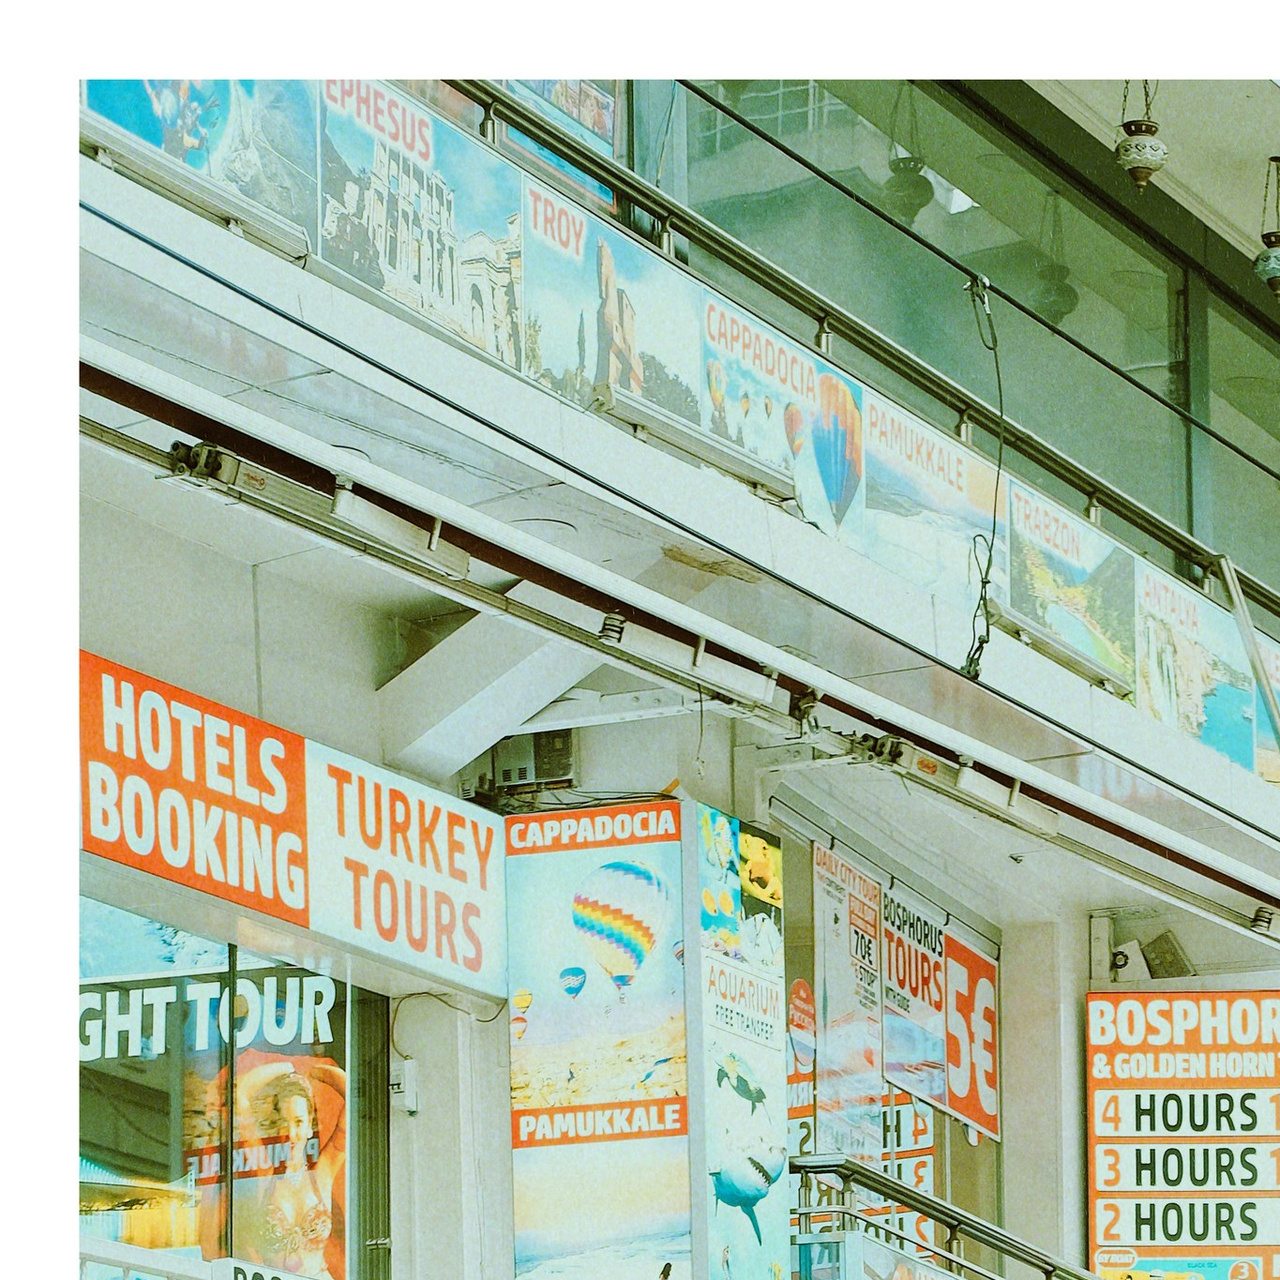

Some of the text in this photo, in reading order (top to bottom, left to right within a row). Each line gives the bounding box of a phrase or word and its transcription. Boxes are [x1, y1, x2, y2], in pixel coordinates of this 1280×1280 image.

[325, 79, 430, 161] EPHESUS
[528, 189, 584, 256] TROY
[706, 303, 816, 404] CAPPADOCIA
[869, 403, 964, 493] PAMUKKALE
[1013, 493, 1080, 559] TRABZON
[101, 673, 288, 815] HOTELS
[87, 761, 306, 910] BOOKING
[327, 763, 494, 891] TURKEY
[509, 809, 676, 849] CAPPADOCIA
[344, 857, 482, 974] TOURS
[882, 890, 945, 958] BOSPHORUS
[707, 965, 780, 1020] AQUARIUM
[884, 927, 944, 1014] TOURS
[187, 975, 337, 1052] TOUR
[714, 1003, 734, 1028] FREE
[735, 1008, 775, 1041] TRANSFER
[946, 956, 998, 1117] 5€
[1092, 1053, 1112, 1079] &
[1114, 1052, 1207, 1079] GOLDEN
[1209, 1052, 1275, 1078] HORN
[519, 1104, 682, 1142] PAMUKKALE
[1101, 1094, 1122, 1132] 4
[1134, 1092, 1258, 1132] HOURS
[1103, 1148, 1121, 1187] 3
[1134, 1147, 1259, 1186] HOURS
[1103, 1203, 1121, 1241] 2
[1134, 1202, 1258, 1241] HOURS
[1238, 1263, 1249, 1280] 3
